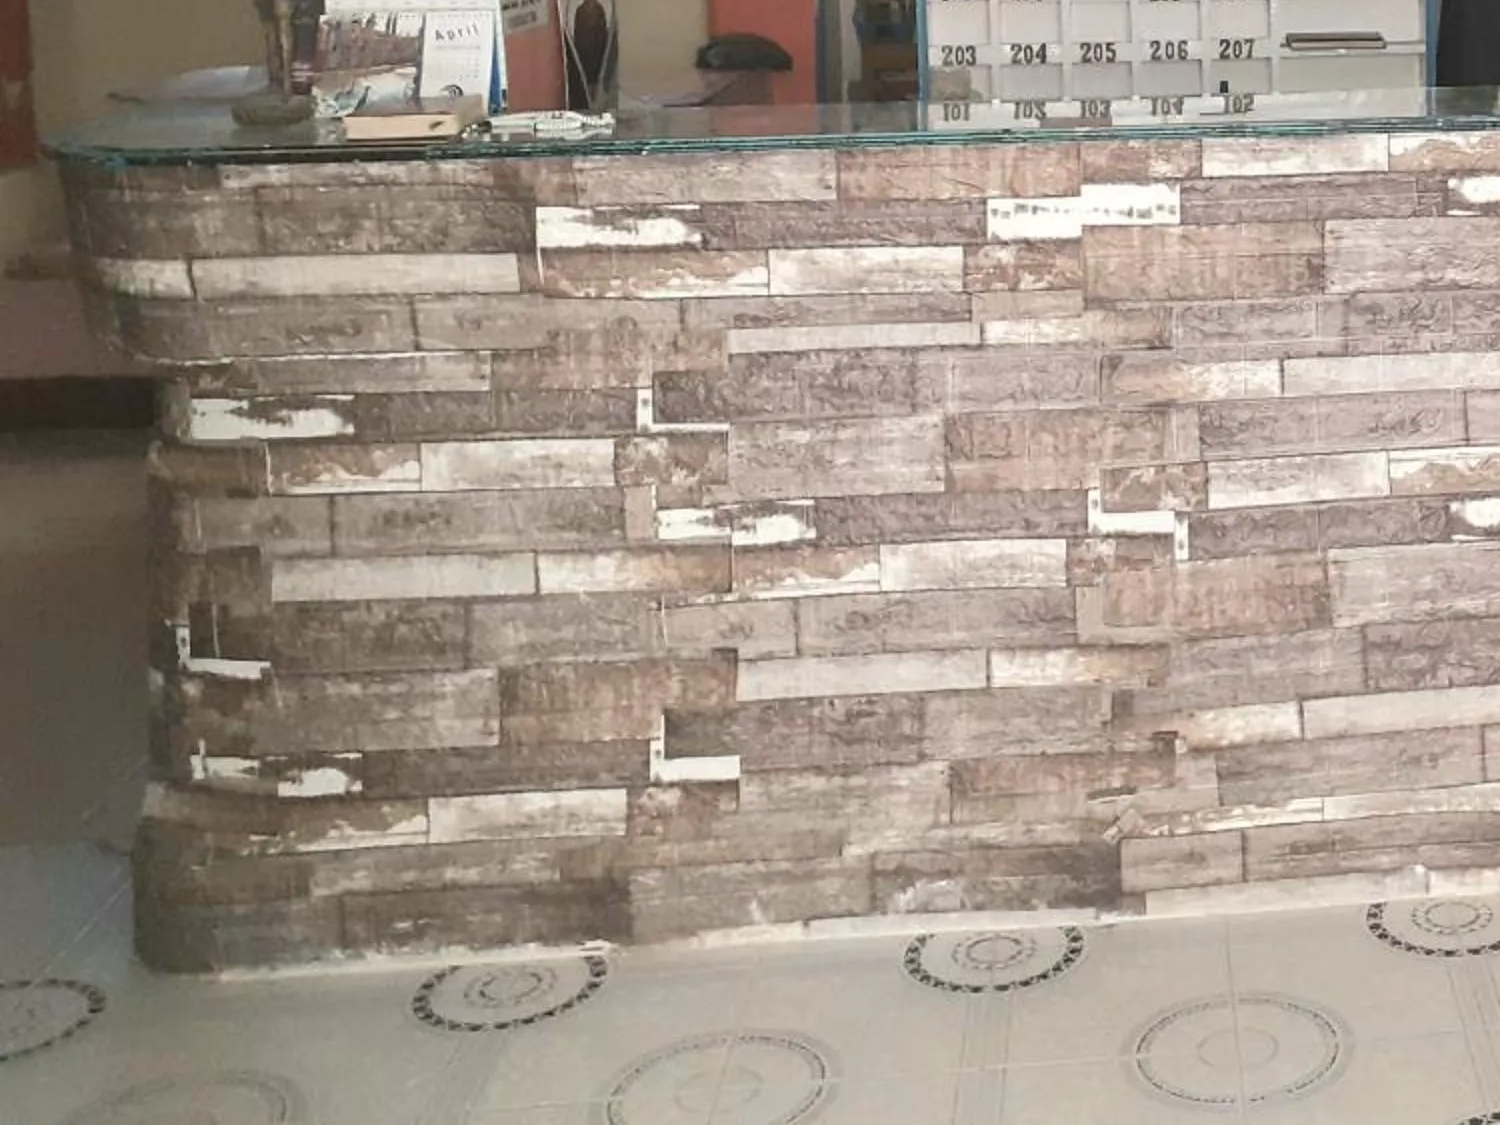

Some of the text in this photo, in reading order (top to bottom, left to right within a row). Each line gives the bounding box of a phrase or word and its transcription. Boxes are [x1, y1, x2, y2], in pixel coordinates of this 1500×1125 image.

[434, 23, 480, 43] April
[941, 44, 977, 67] 203
[1010, 43, 1047, 65] 204
[1080, 42, 1117, 64] 205
[1150, 40, 1188, 60] 206
[1219, 38, 1255, 60] 207
